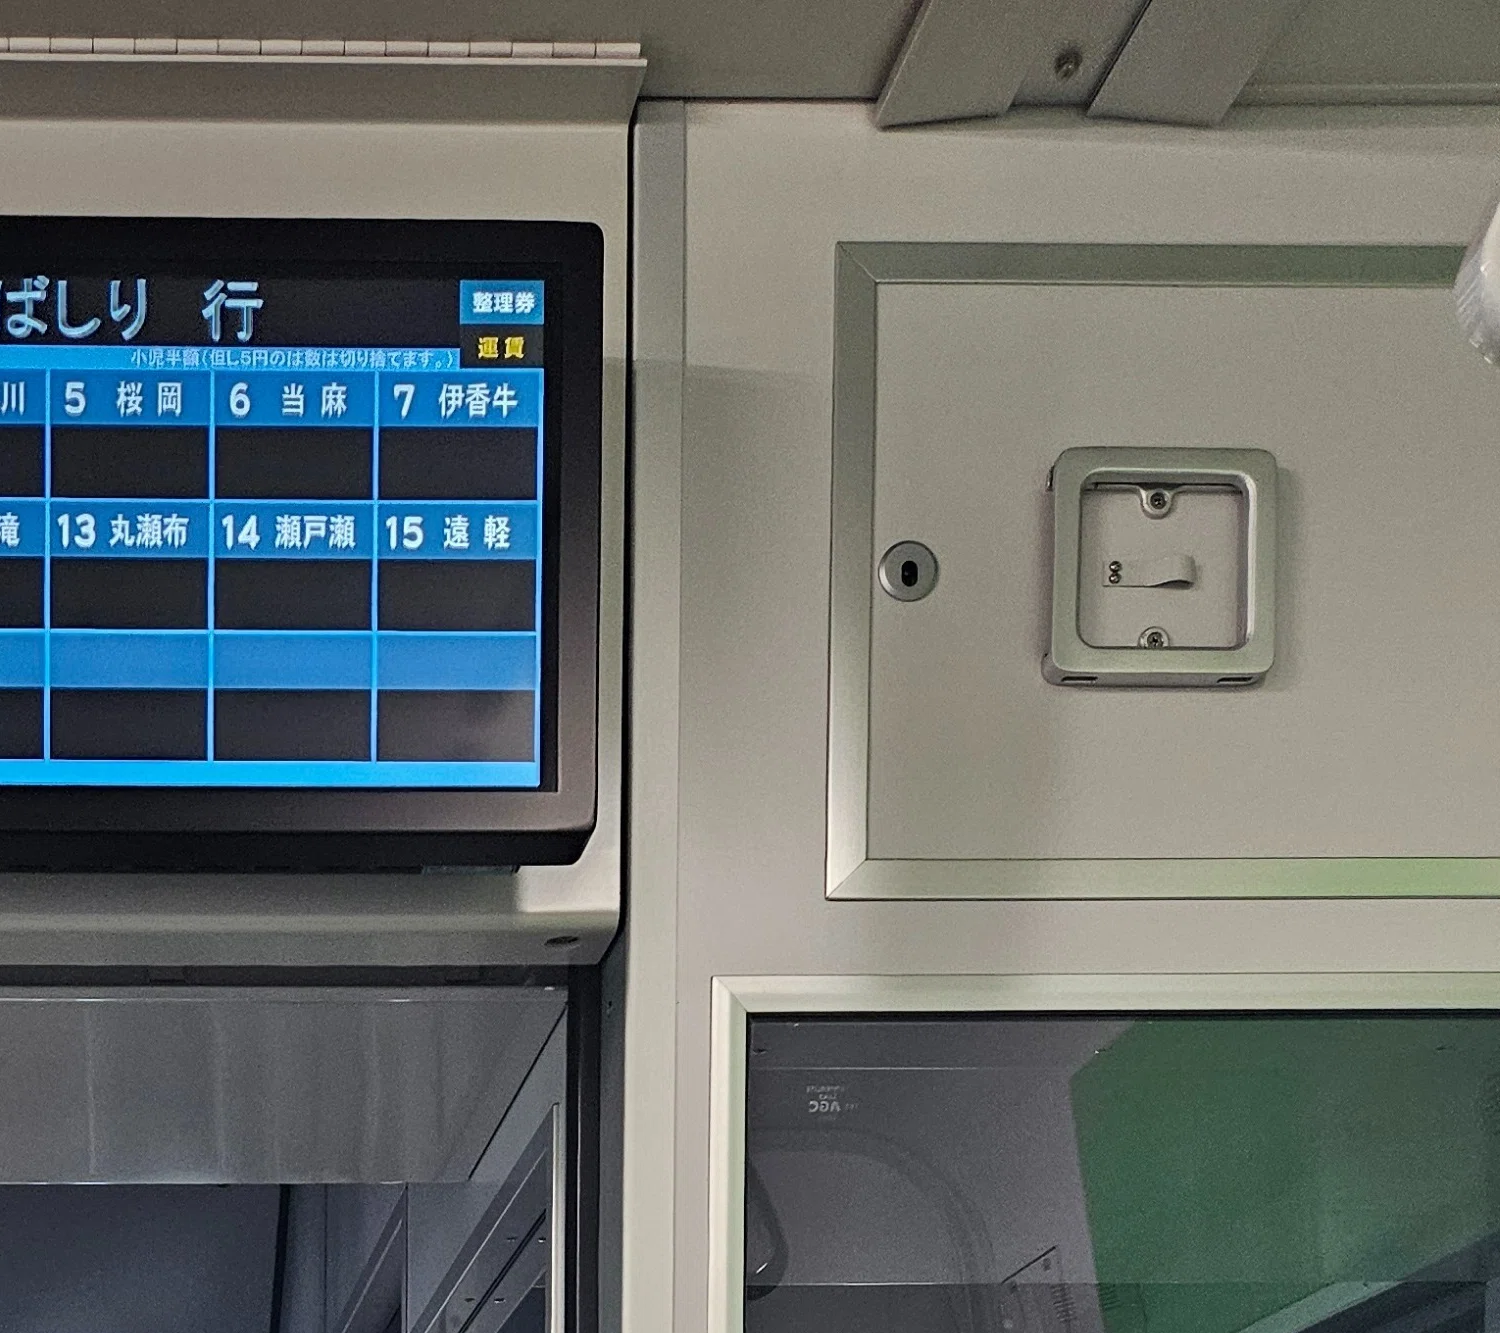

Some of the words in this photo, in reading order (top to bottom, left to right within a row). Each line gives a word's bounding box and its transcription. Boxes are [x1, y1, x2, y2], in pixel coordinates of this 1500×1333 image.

[201, 278, 265, 342] 行
[472, 291, 536, 315] 整理券
[477, 336, 525, 360] 運賃
[64, 381, 87, 417] 5
[116, 380, 183, 416] 桜岡
[229, 382, 251, 418] 6
[280, 382, 348, 418] 当麻
[393, 384, 415, 419] 7
[438, 382, 519, 420] 伊香牛
[57, 514, 97, 549] 13
[221, 515, 261, 550] 14
[385, 515, 424, 551] 15
[442, 514, 511, 551] 遠軽
